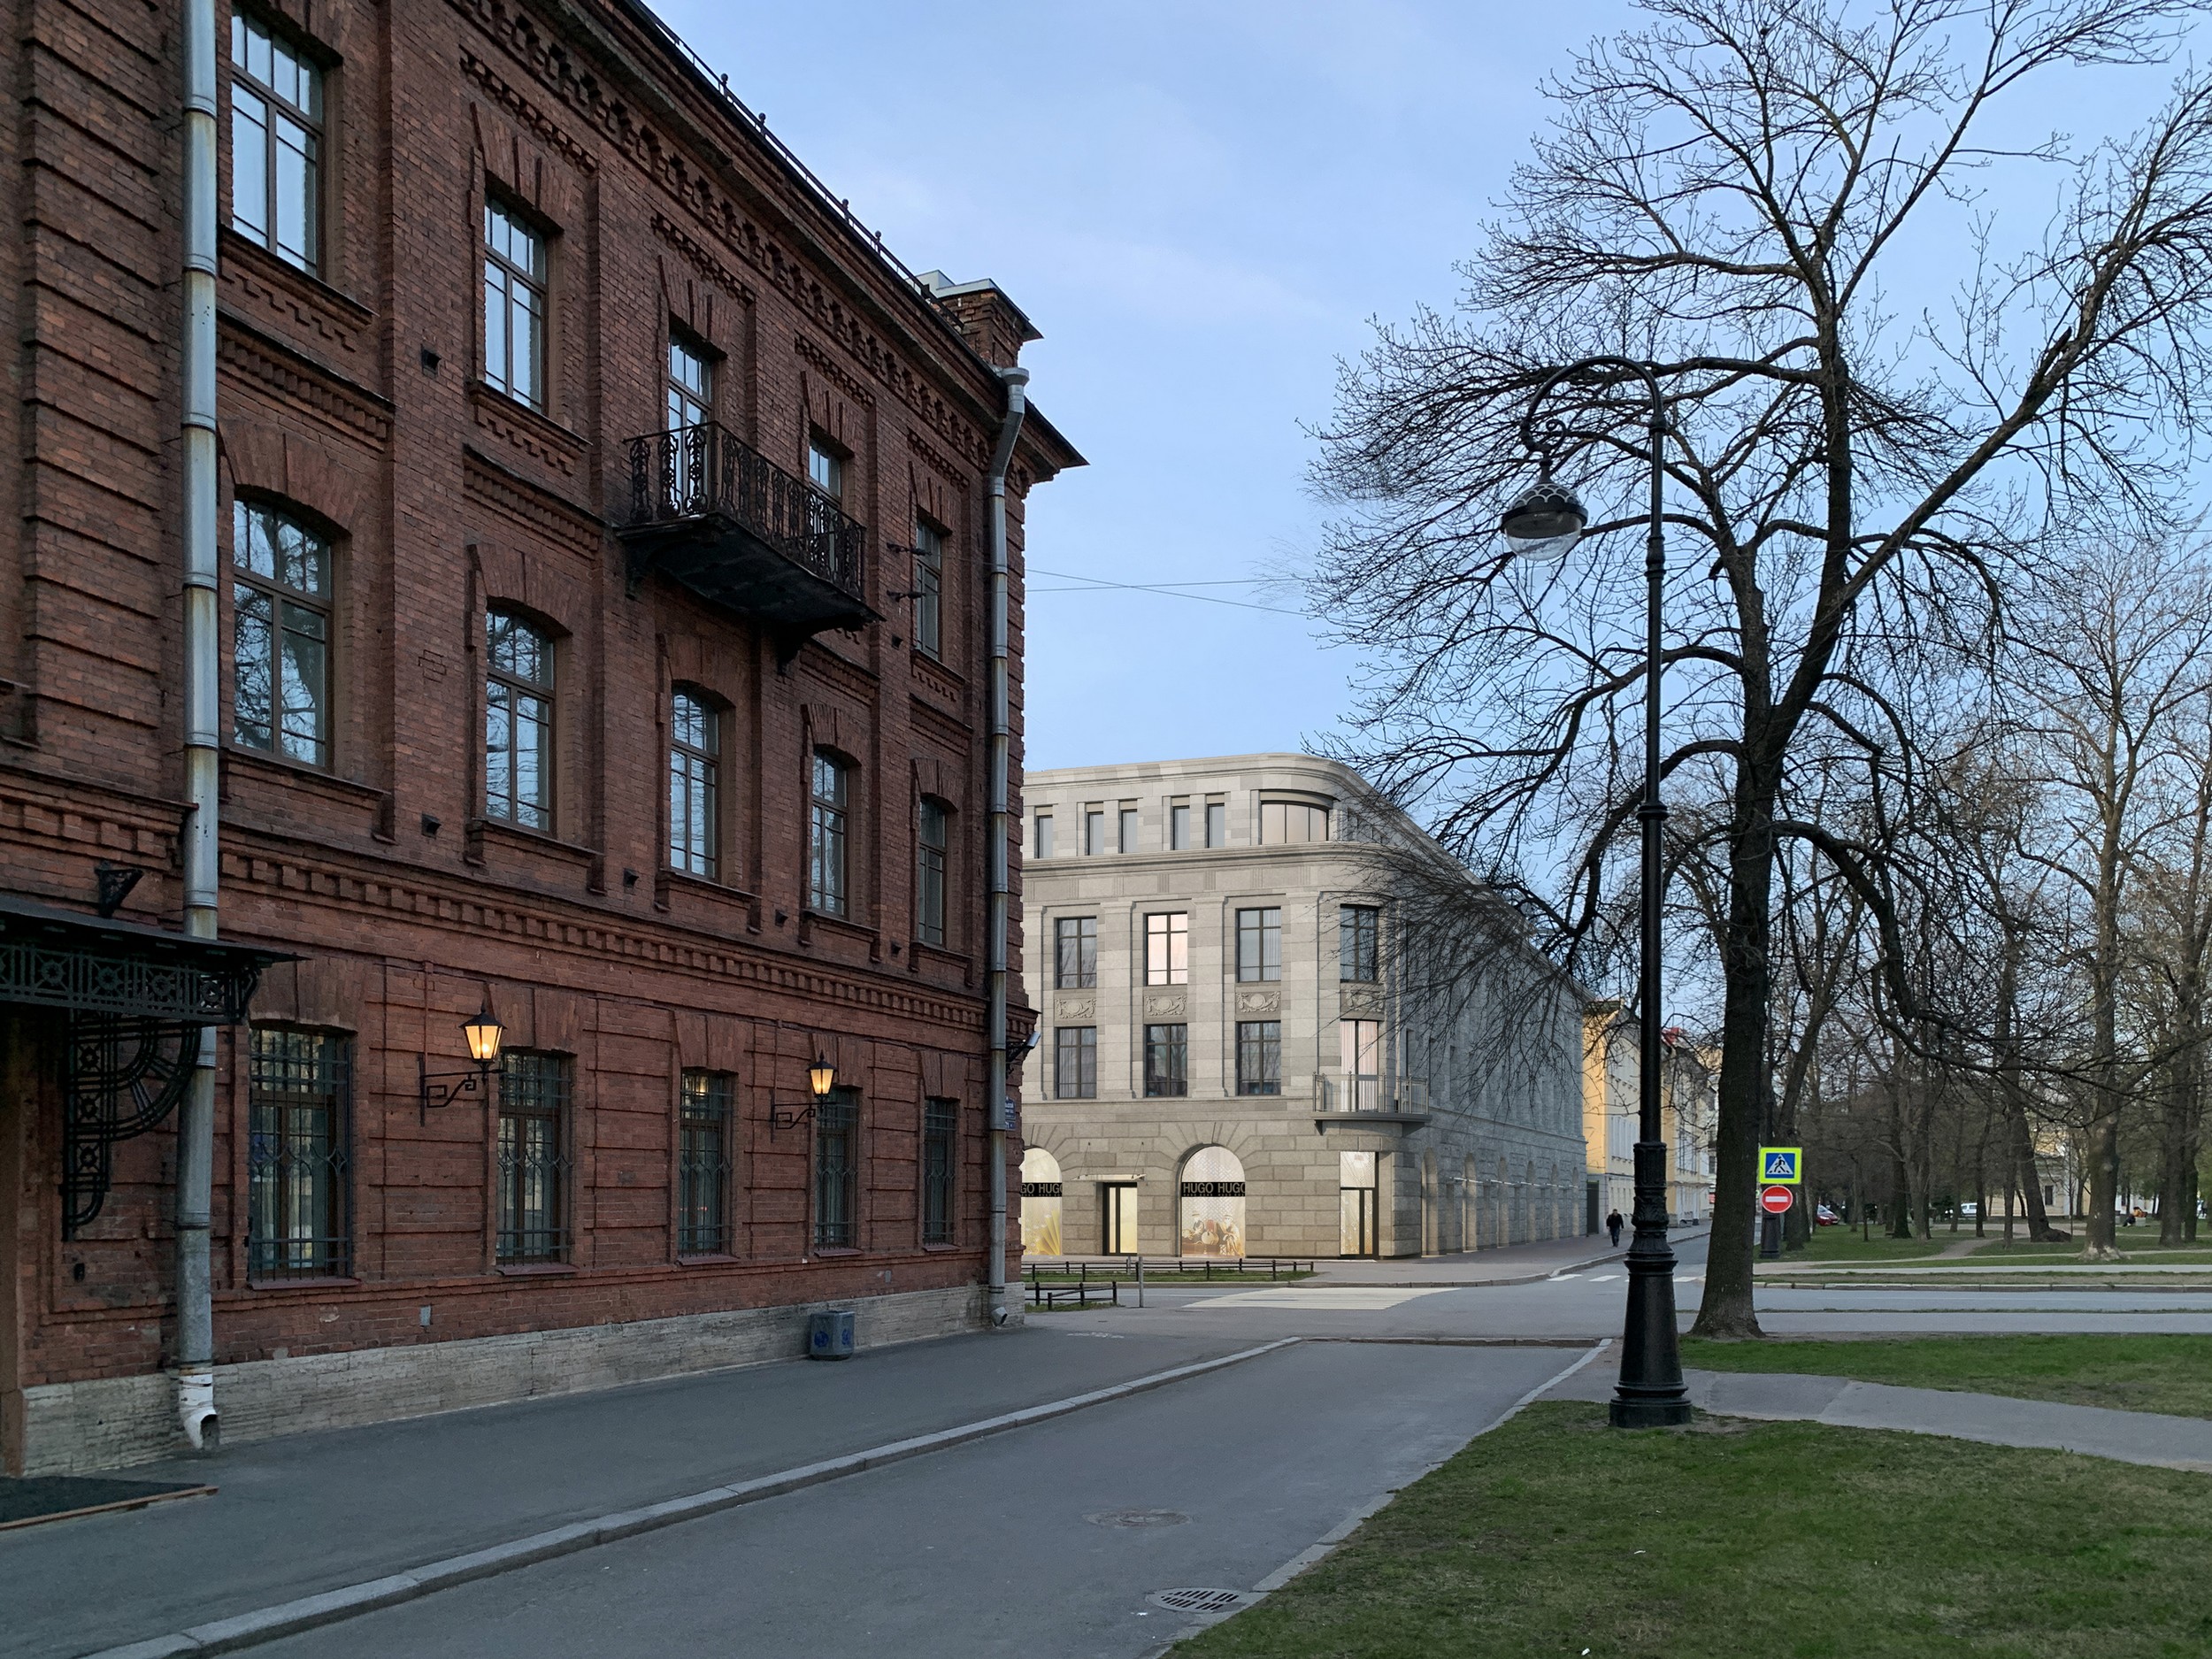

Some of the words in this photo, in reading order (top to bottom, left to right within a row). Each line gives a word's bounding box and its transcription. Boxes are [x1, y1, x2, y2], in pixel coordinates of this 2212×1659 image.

[1020, 1183, 1034, 1194] GO
[1038, 1183, 1062, 1194] HUG
[1183, 1183, 1214, 1194] HUGO
